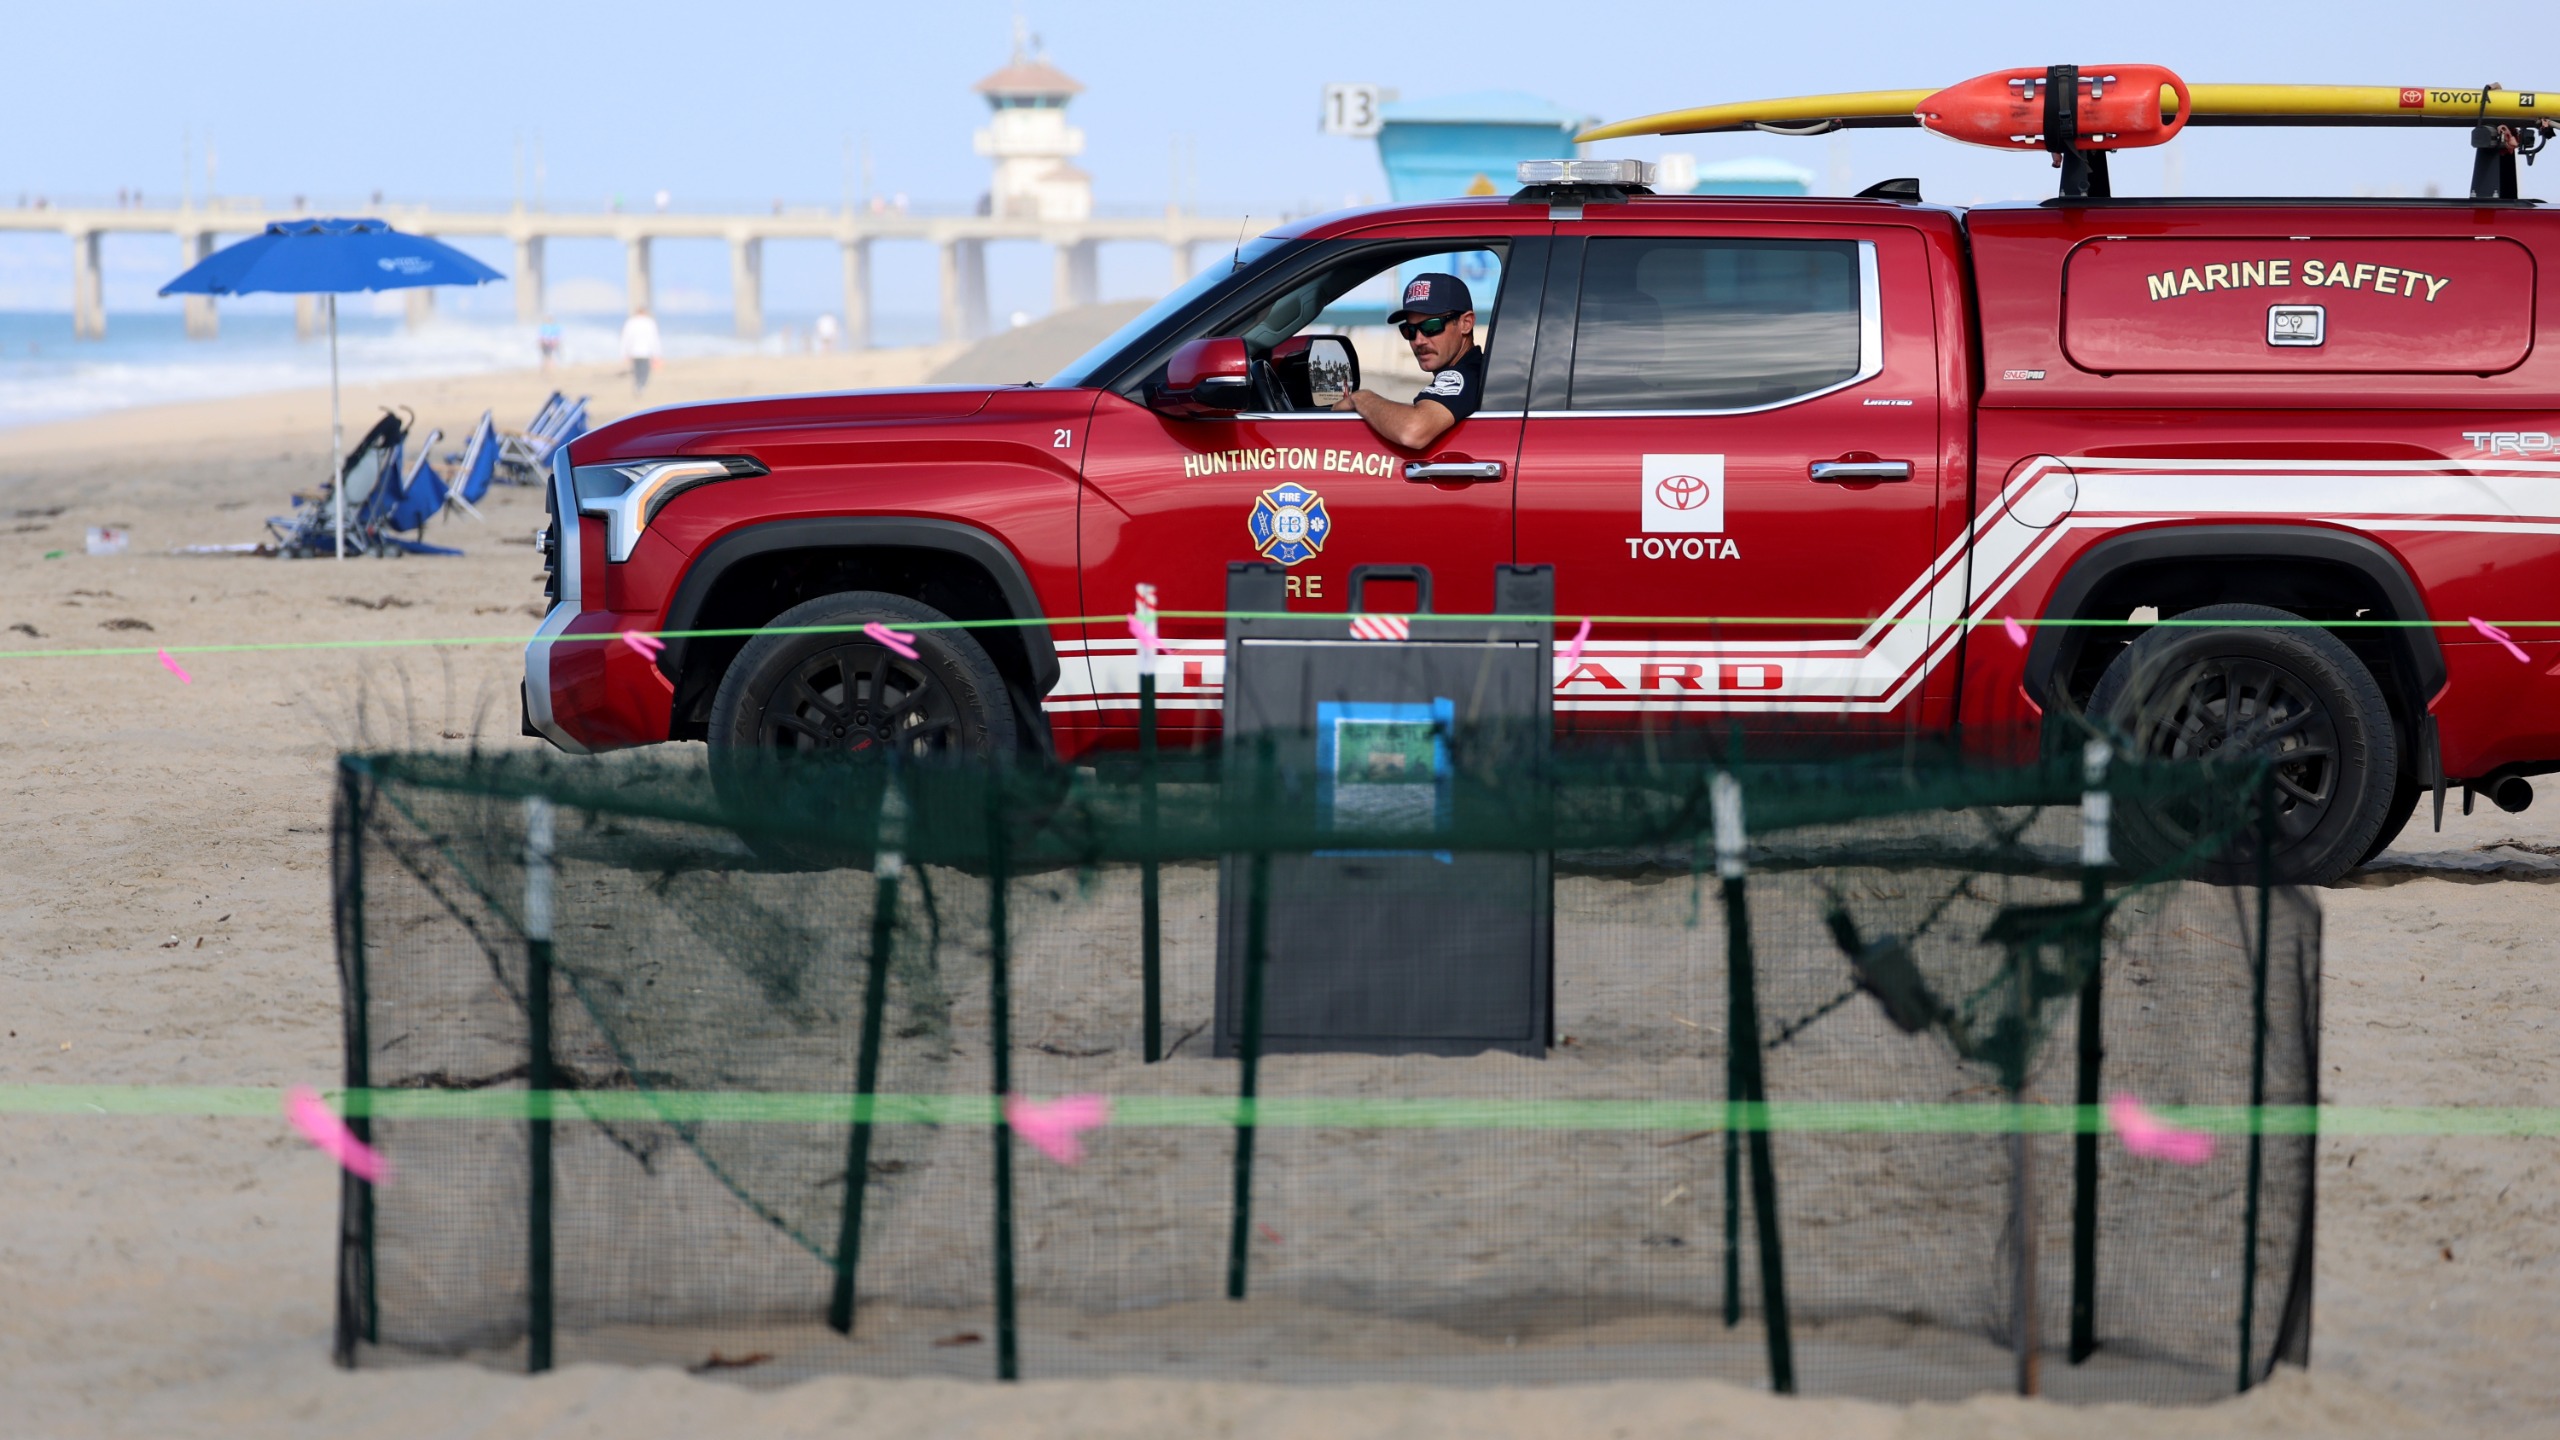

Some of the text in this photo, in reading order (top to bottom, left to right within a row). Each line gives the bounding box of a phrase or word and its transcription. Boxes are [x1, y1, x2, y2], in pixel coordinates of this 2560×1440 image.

[1333, 92, 1373, 127] 13
[2520, 94, 2533, 105] 21
[2146, 259, 2451, 303] MARINE SAFETY
[1053, 428, 1071, 448] 21
[2462, 432, 2553, 456] TRD
[1184, 447, 1395, 479] HUNTINGTON BEACH
[1279, 492, 1301, 503] FIRE
[1625, 537, 1741, 560] TOYOTA
